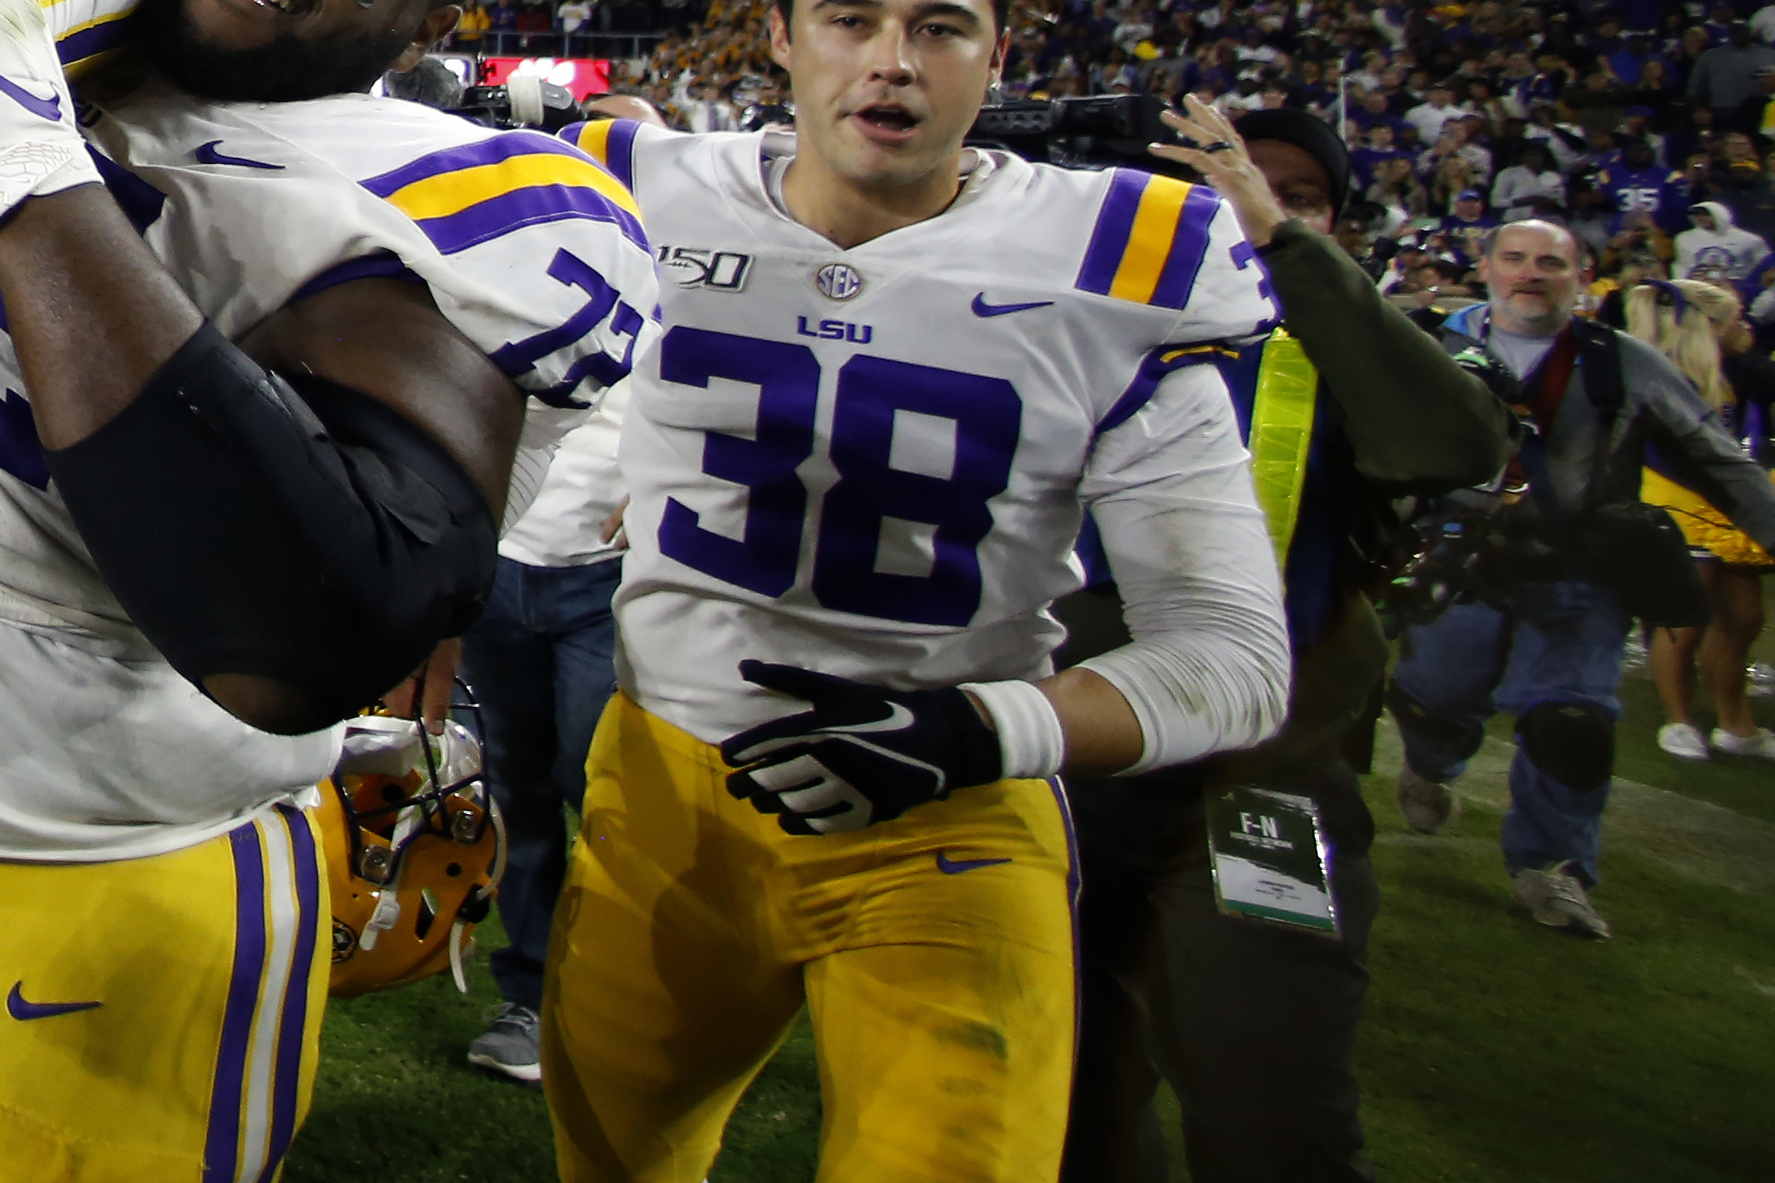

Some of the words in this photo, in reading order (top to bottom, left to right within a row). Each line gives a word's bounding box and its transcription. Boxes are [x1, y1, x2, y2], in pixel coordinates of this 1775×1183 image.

[1616, 187, 1660, 213] 35
[657, 245, 752, 291] 150
[817, 264, 861, 299] SEC
[486, 246, 645, 410] 72
[796, 315, 872, 344] LSU
[658, 325, 1024, 628] 38
